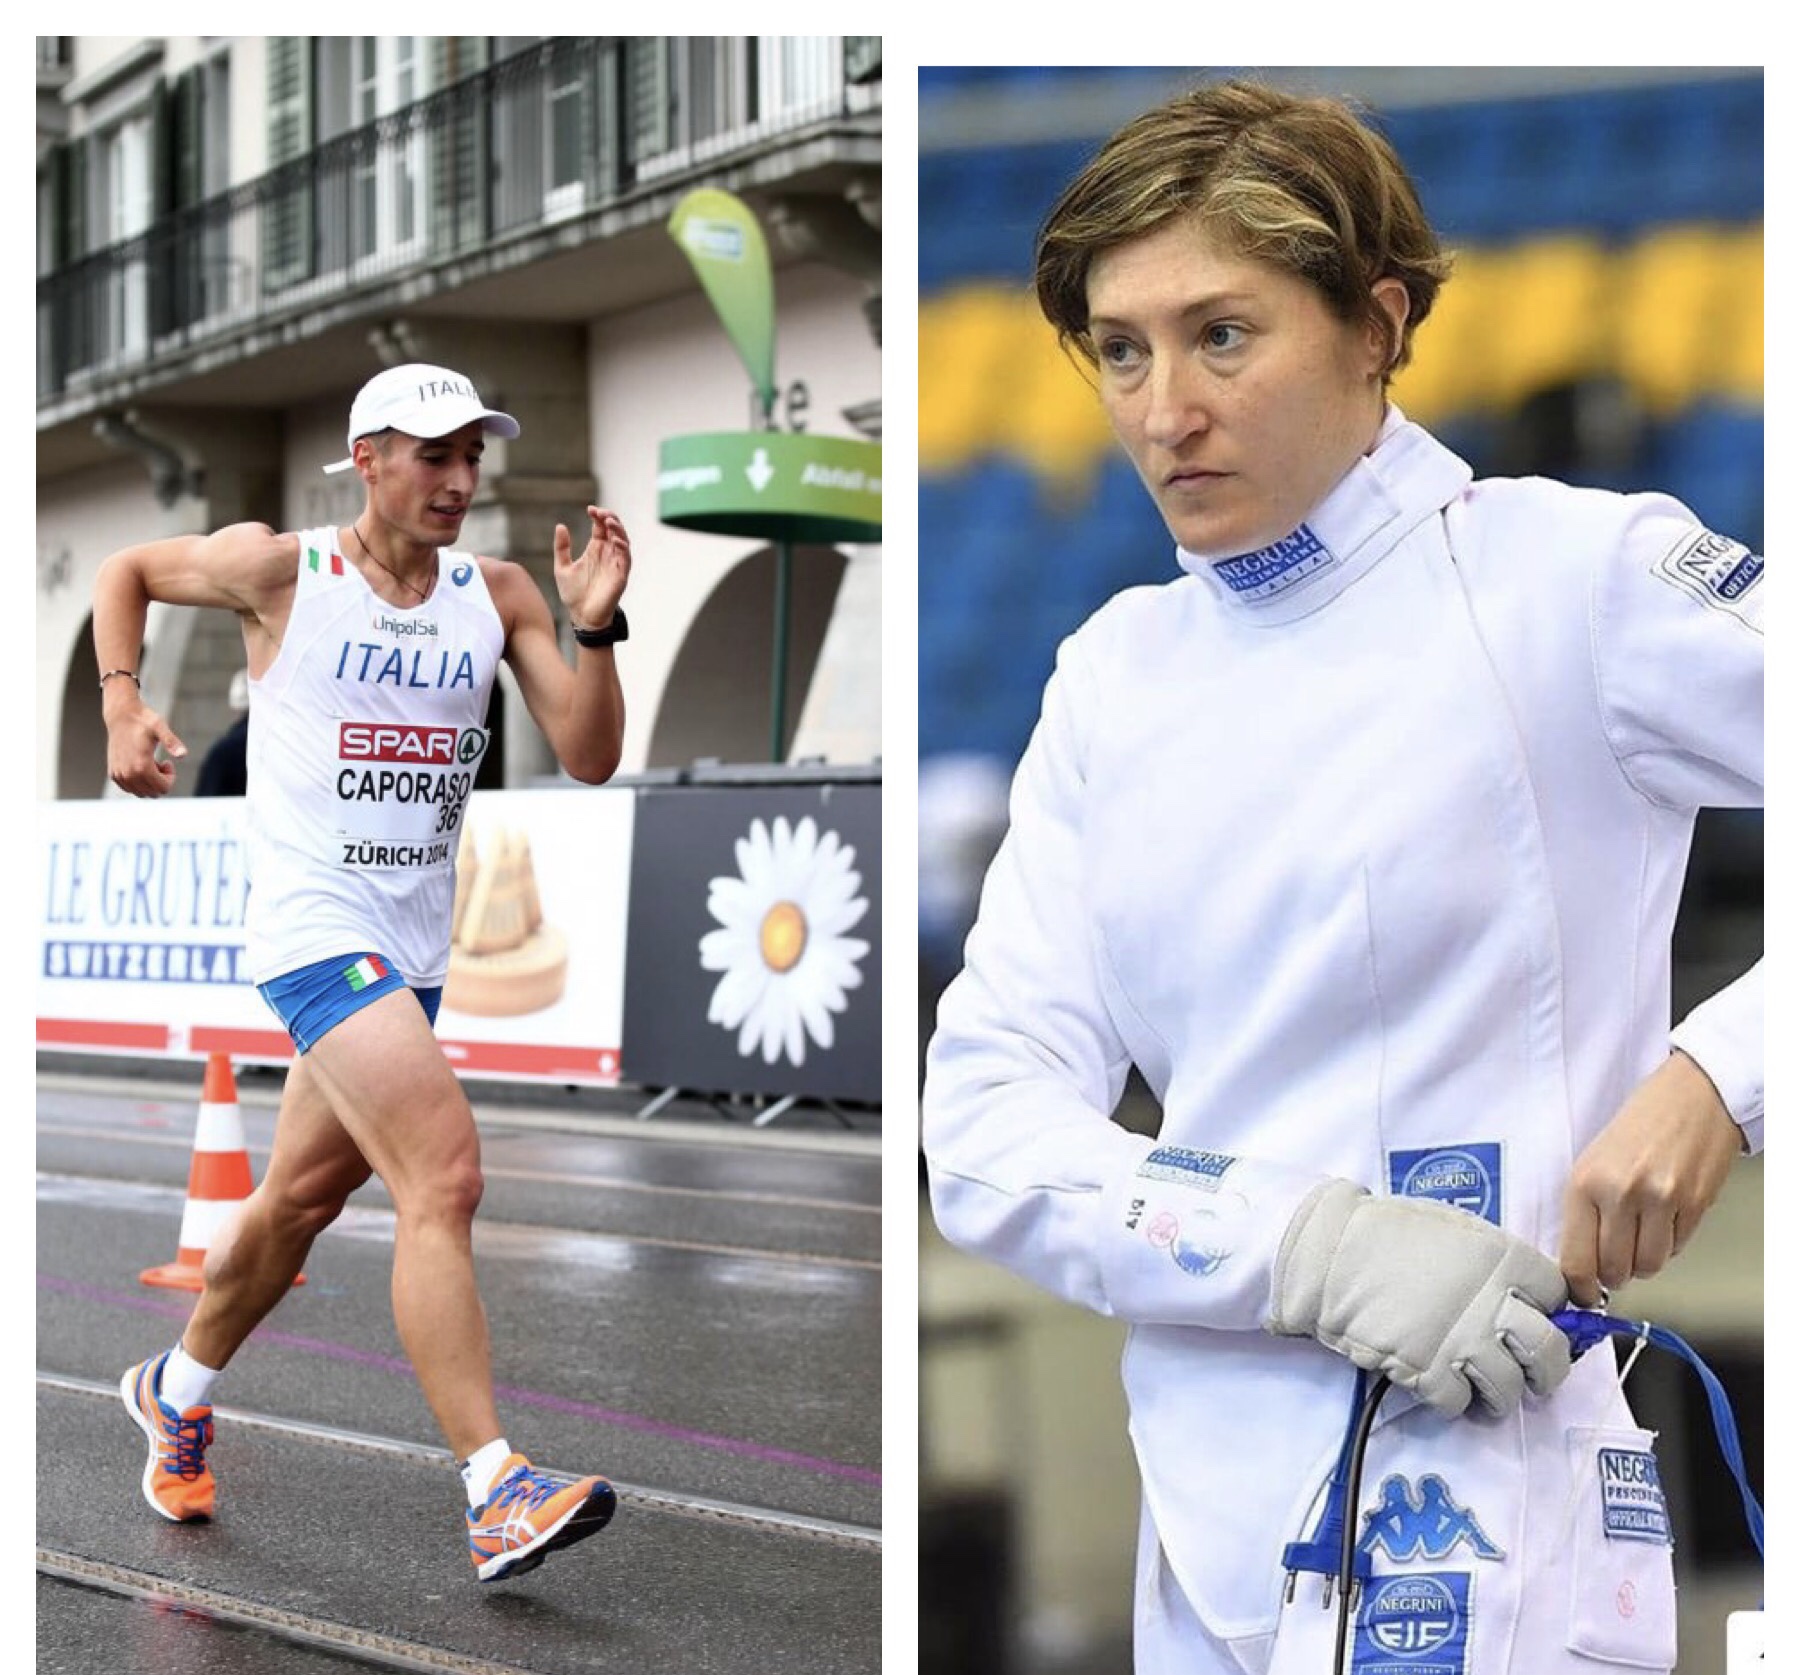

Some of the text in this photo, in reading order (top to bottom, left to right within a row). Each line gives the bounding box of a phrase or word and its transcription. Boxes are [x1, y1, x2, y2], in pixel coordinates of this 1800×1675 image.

[1215, 526, 1314, 581] NEGRINI
[1682, 535, 1736, 577] NEG
[373, 614, 439, 639] UnipolSai
[335, 640, 475, 690] ITALIA
[343, 727, 456, 759] SPAR
[336, 767, 472, 804] CAPORASO
[435, 802, 462, 834] 36
[342, 840, 450, 867] ZÜRICH 2014
[47, 841, 92, 925] LE
[1413, 1172, 1477, 1190] NEGRINI
[1379, 1597, 1443, 1613] NEGRINI
